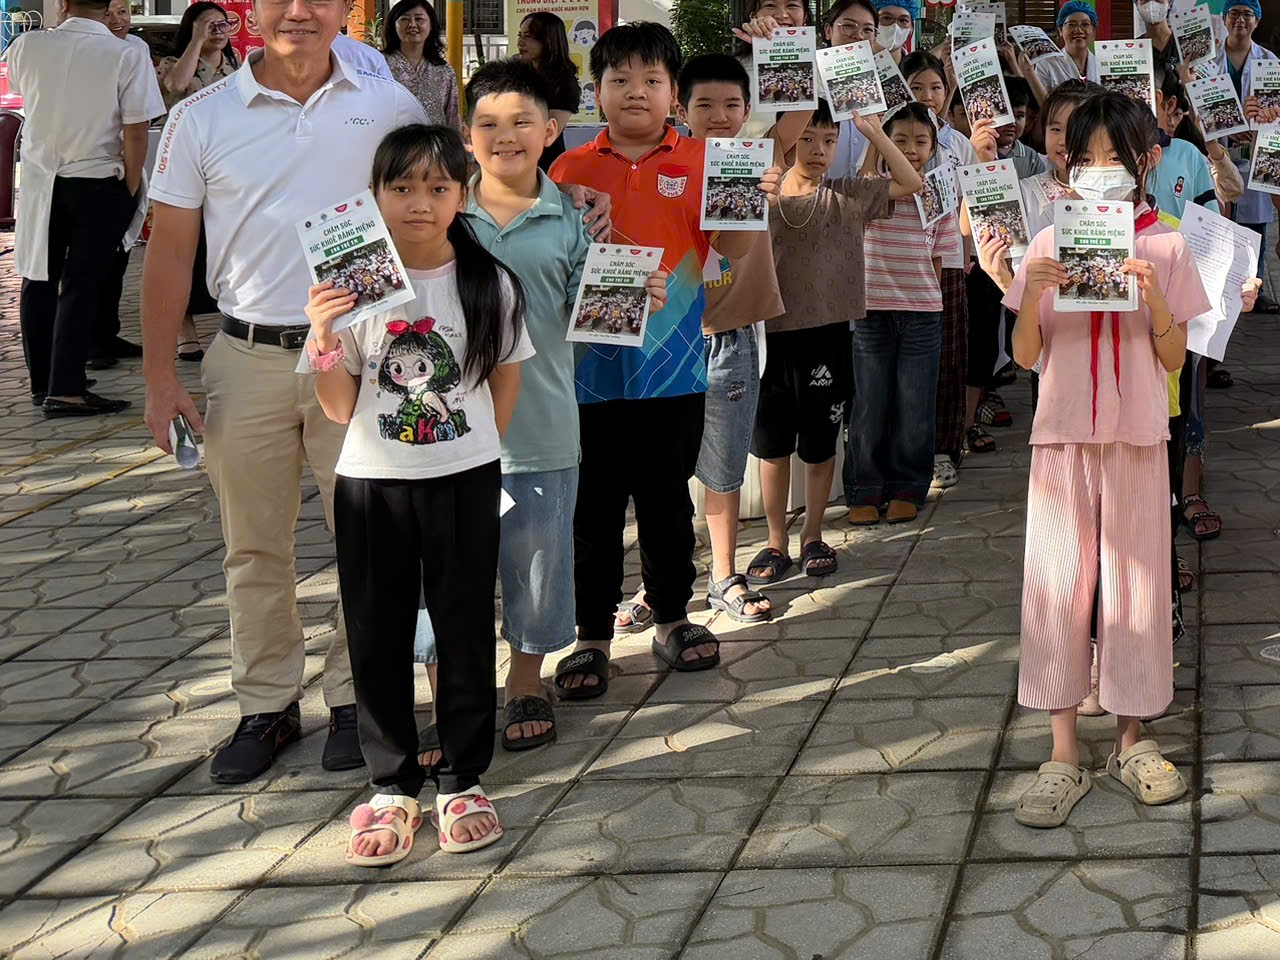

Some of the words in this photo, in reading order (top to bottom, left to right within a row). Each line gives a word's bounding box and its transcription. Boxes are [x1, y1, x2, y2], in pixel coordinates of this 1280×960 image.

[163, 123, 176, 154] YEARS
[174, 108, 184, 121] OF
[184, 81, 227, 108] QUALITY
[323, 222, 340, 236] CHĂM
[340, 219, 353, 230] SÓC
[338, 228, 356, 242] RĂNG
[356, 221, 376, 234] MIỆNG
[1079, 219, 1094, 227] CHĂM
[1089, 228, 1106, 236] RĂNG
[1106, 228, 1126, 237] MIỆNG
